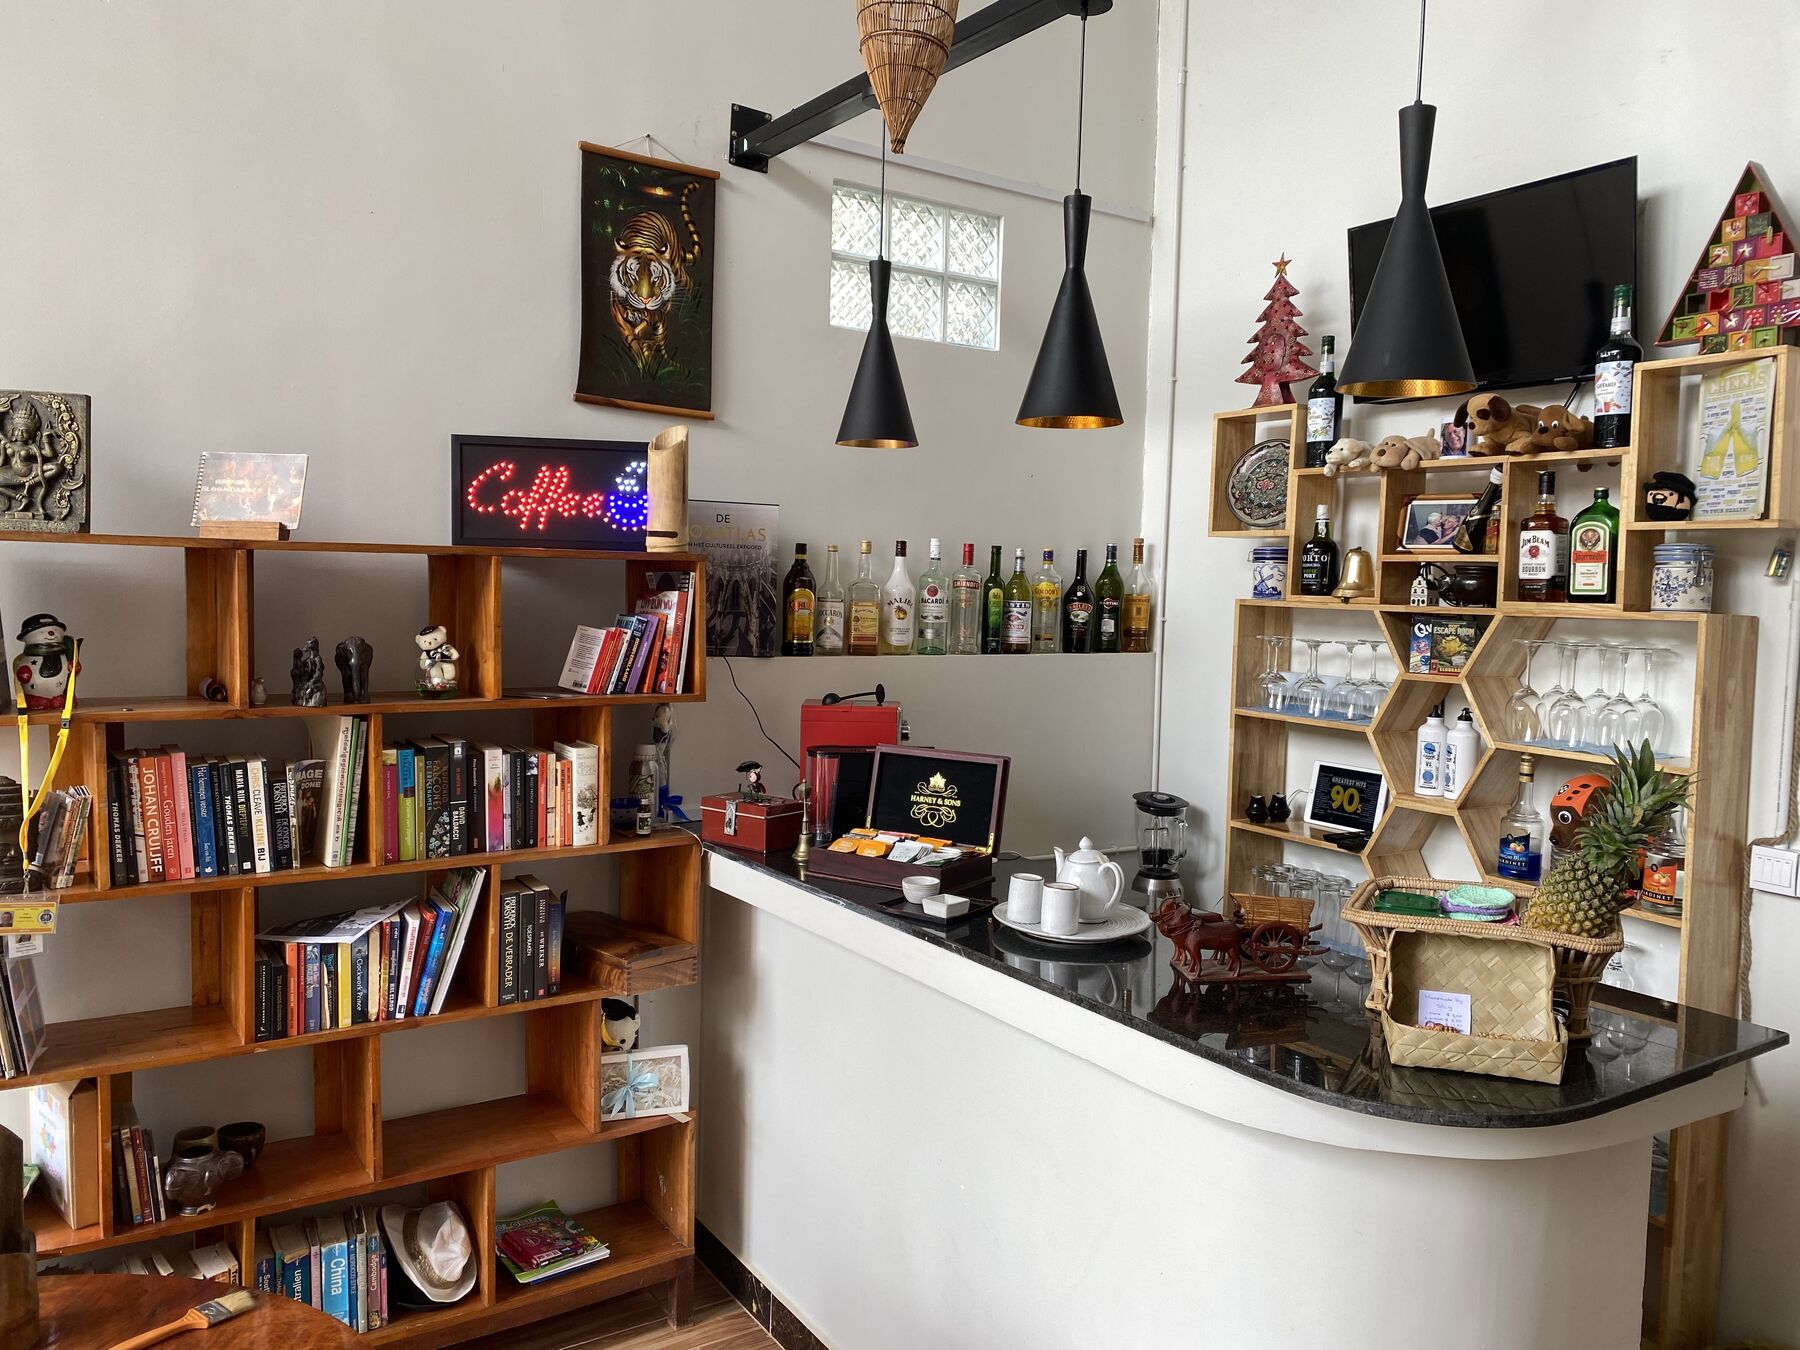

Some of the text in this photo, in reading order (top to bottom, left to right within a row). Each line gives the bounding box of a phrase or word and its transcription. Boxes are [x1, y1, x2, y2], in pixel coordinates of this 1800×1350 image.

[467, 461, 607, 530] Coffee
[716, 513, 730, 524] DE
[1302, 554, 1328, 562] ORTO
[1521, 535, 1550, 549] JIM BEAM
[1433, 626, 1475, 637] ESCAPE ROOM
[197, 766, 207, 777] Het
[235, 769, 244, 789] MARIA
[432, 760, 442, 810] FALCONES
[1331, 776, 1356, 786] GREATEST
[250, 767, 266, 862] CHRIS CLEAVE KLEINE BIJ
[273, 783, 283, 814] FORSYTH
[910, 794, 961, 807] HARNEY & SONS
[111, 802, 123, 863] THOMAS DEKKER
[142, 767, 163, 873] JOHAN CRUIJFF
[163, 799, 175, 859] Gouden jaren
[224, 795, 236, 854] THOMAS DEKKER
[503, 897, 512, 930] FORSYTH
[504, 932, 513, 988] DE VERRADER
[330, 1258, 346, 1295] China
[370, 1254, 379, 1291] Cambodge
